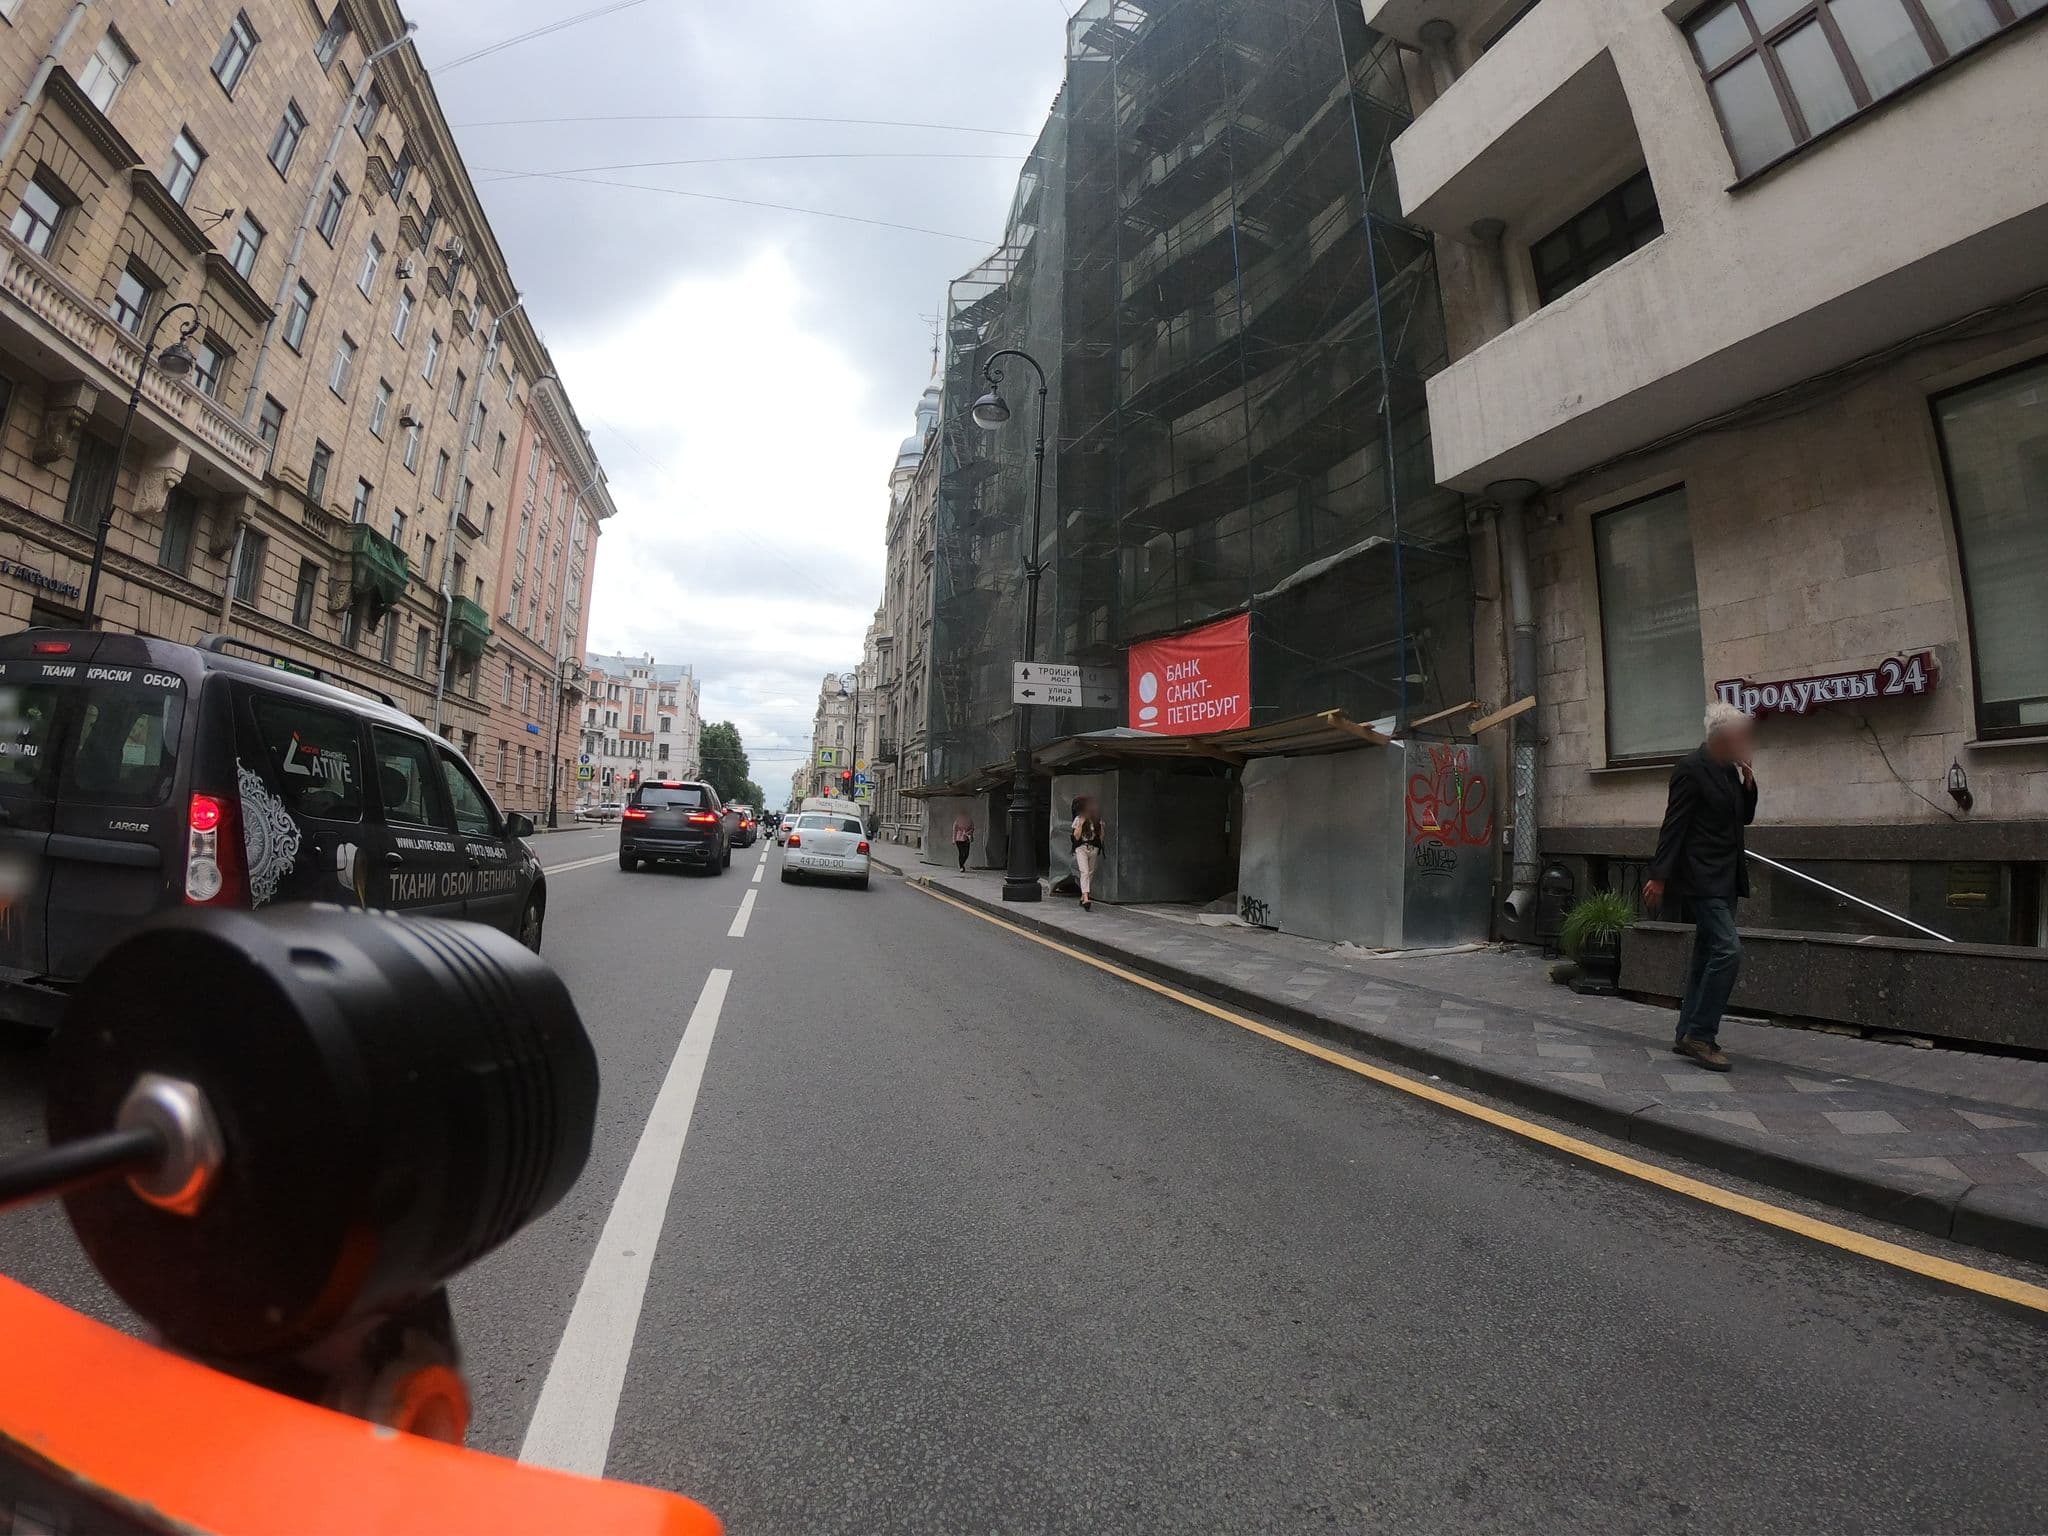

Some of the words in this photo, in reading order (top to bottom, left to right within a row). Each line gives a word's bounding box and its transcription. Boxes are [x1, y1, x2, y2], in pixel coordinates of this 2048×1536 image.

[41, 665, 76, 678] ТКАНИ
[86, 668, 132, 682] КРАСКИ
[142, 674, 181, 689] ОБОИ
[1166, 658, 1200, 682] БАНК
[1048, 695, 1073, 703] МИРА
[1167, 679, 1212, 704] САНКТ-
[1718, 674, 1878, 717] Продукты
[1881, 657, 1929, 696] 24
[1167, 695, 1240, 725] ПЕТЕРБУРГ
[109, 821, 149, 833] LARGUS
[390, 873, 436, 901] ТКАНИ
[441, 871, 473, 897] ОБОИ
[475, 869, 517, 892] ЛЕПНИНА
